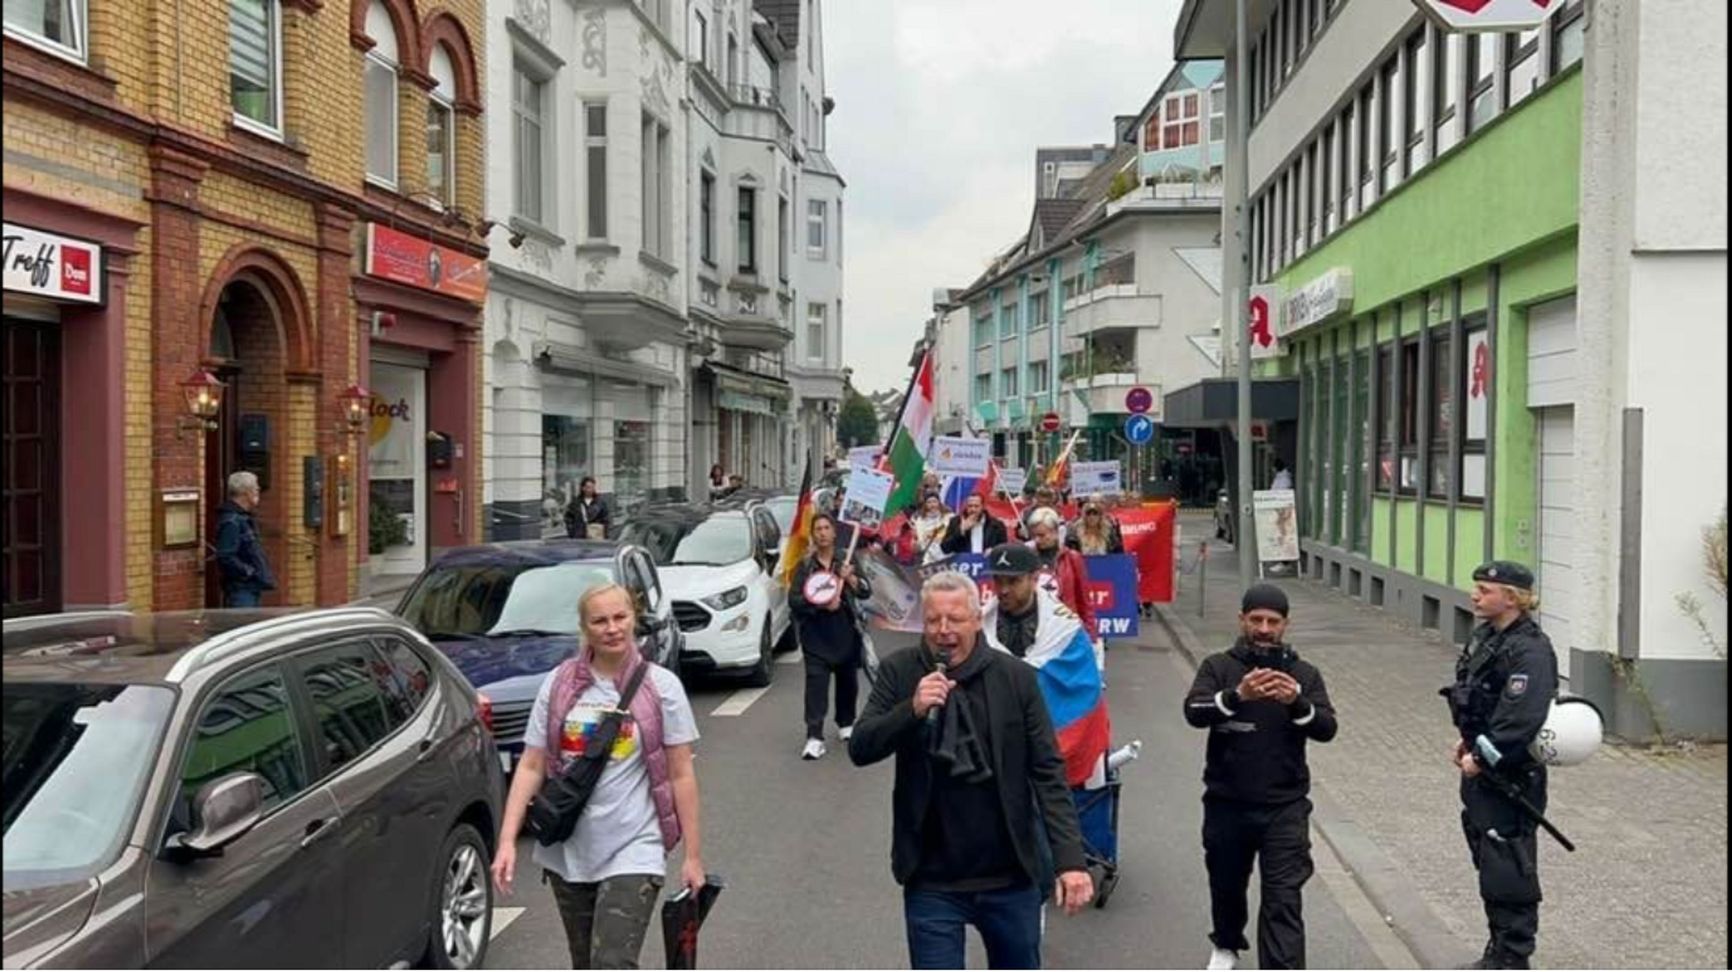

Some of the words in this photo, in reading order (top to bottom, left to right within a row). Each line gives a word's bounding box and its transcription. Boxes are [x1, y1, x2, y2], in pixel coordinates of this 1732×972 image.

[3, 235, 55, 288] Treff
[368, 397, 410, 422] lock
[1094, 617, 1131, 633] RW
